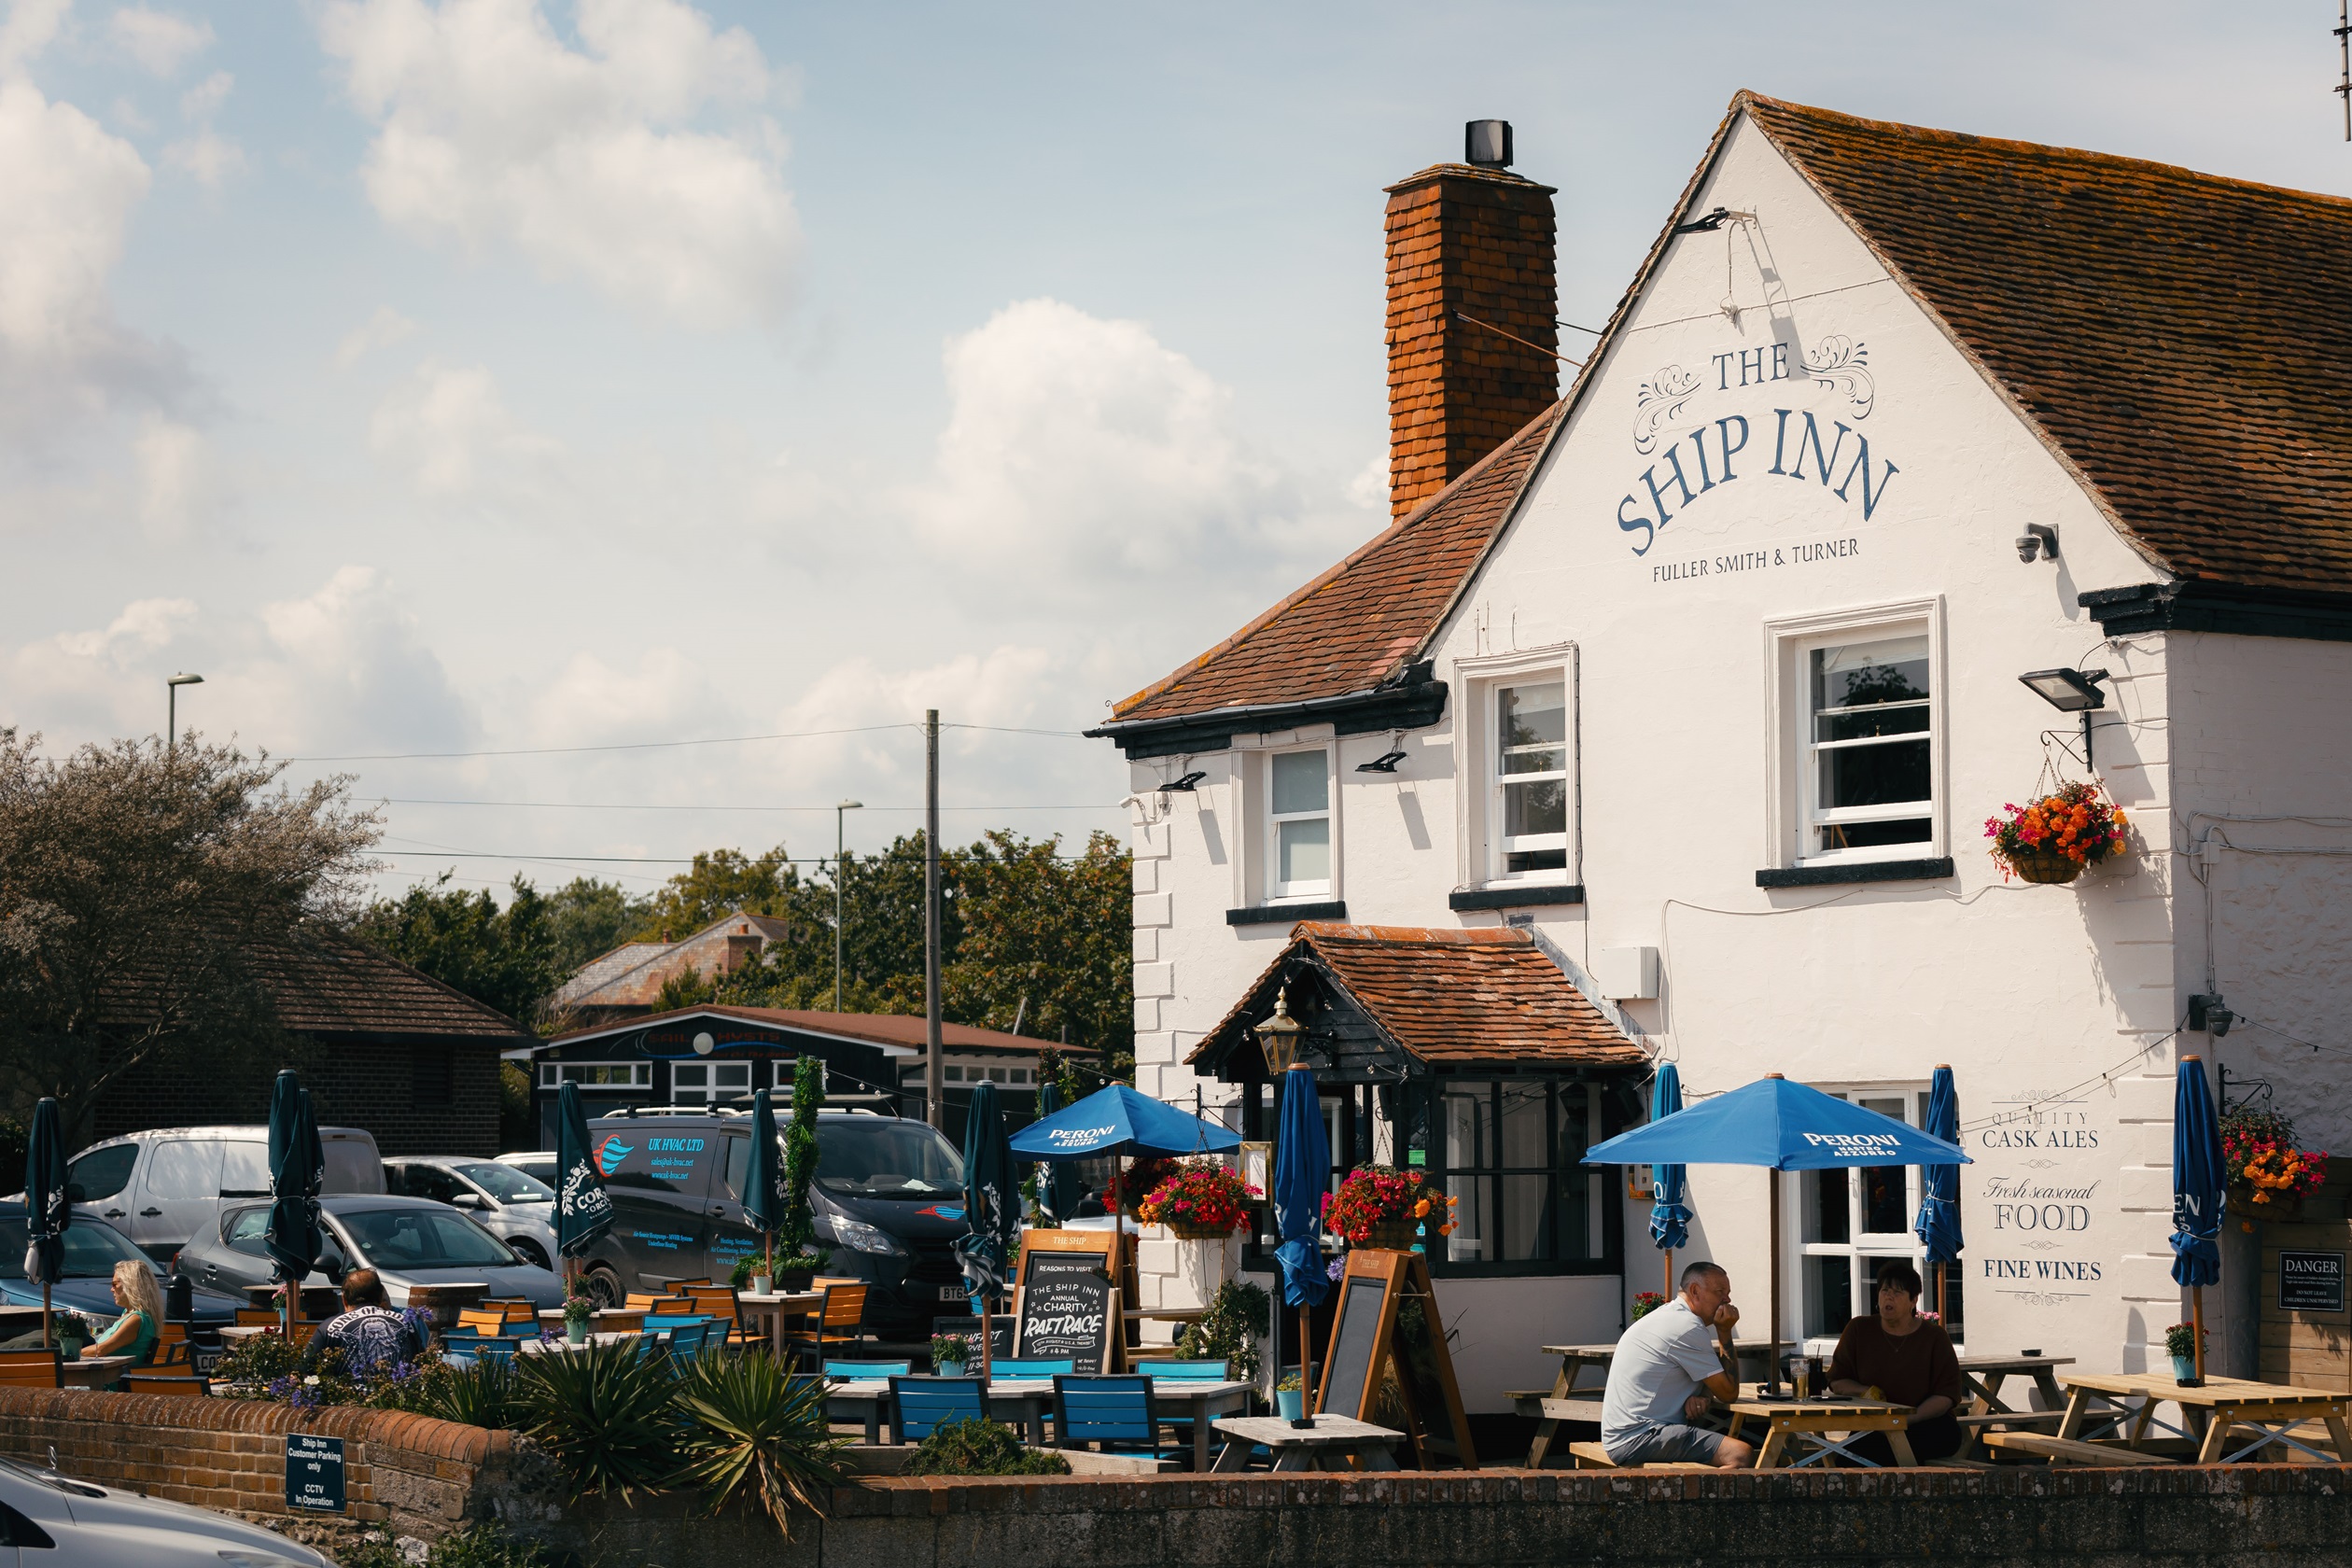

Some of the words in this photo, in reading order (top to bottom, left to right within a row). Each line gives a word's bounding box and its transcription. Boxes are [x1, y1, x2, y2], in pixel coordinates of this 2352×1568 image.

[1712, 342, 1790, 391] THE
[1617, 414, 1750, 557] SHIP
[1768, 408, 1900, 522] INN
[1653, 559, 1709, 582] FULLER
[1715, 551, 1767, 574] SMITH
[1774, 548, 1785, 566] &
[1792, 538, 1859, 562] TURNER
[1993, 1113, 2088, 1126] QUALITY
[1049, 1124, 1116, 1139] PERONI
[648, 1138, 663, 1151] UK
[662, 1138, 686, 1151] HVAC
[686, 1139, 705, 1152] LTD
[1802, 1133, 1902, 1146] PERONI
[1982, 1130, 2039, 1148] CASK
[2045, 1130, 2099, 1149] ALES
[1983, 1176, 2031, 1199] Fresh
[2029, 1179, 2101, 1200] seasonal
[1993, 1204, 2090, 1231] FOOD
[1984, 1260, 2031, 1278] FINE
[2035, 1261, 2102, 1281] WINES
[2285, 1260, 2338, 1273] DANGER
[1033, 1285, 1051, 1296] THE
[1056, 1283, 1079, 1292] SHIP
[1082, 1286, 1100, 1297] INN
[1043, 1302, 1087, 1313] CHARITY
[1024, 1317, 1065, 1337] RAFT
[1062, 1314, 1103, 1335] RACE
[302, 1438, 316, 1449] Ship
[317, 1440, 327, 1448] Inn
[288, 1448, 317, 1459] Customer
[318, 1451, 341, 1463] Parking
[308, 1463, 322, 1472] only
[305, 1484, 324, 1494] CCTV
[295, 1495, 302, 1503] In
[302, 1495, 334, 1506] Operation
